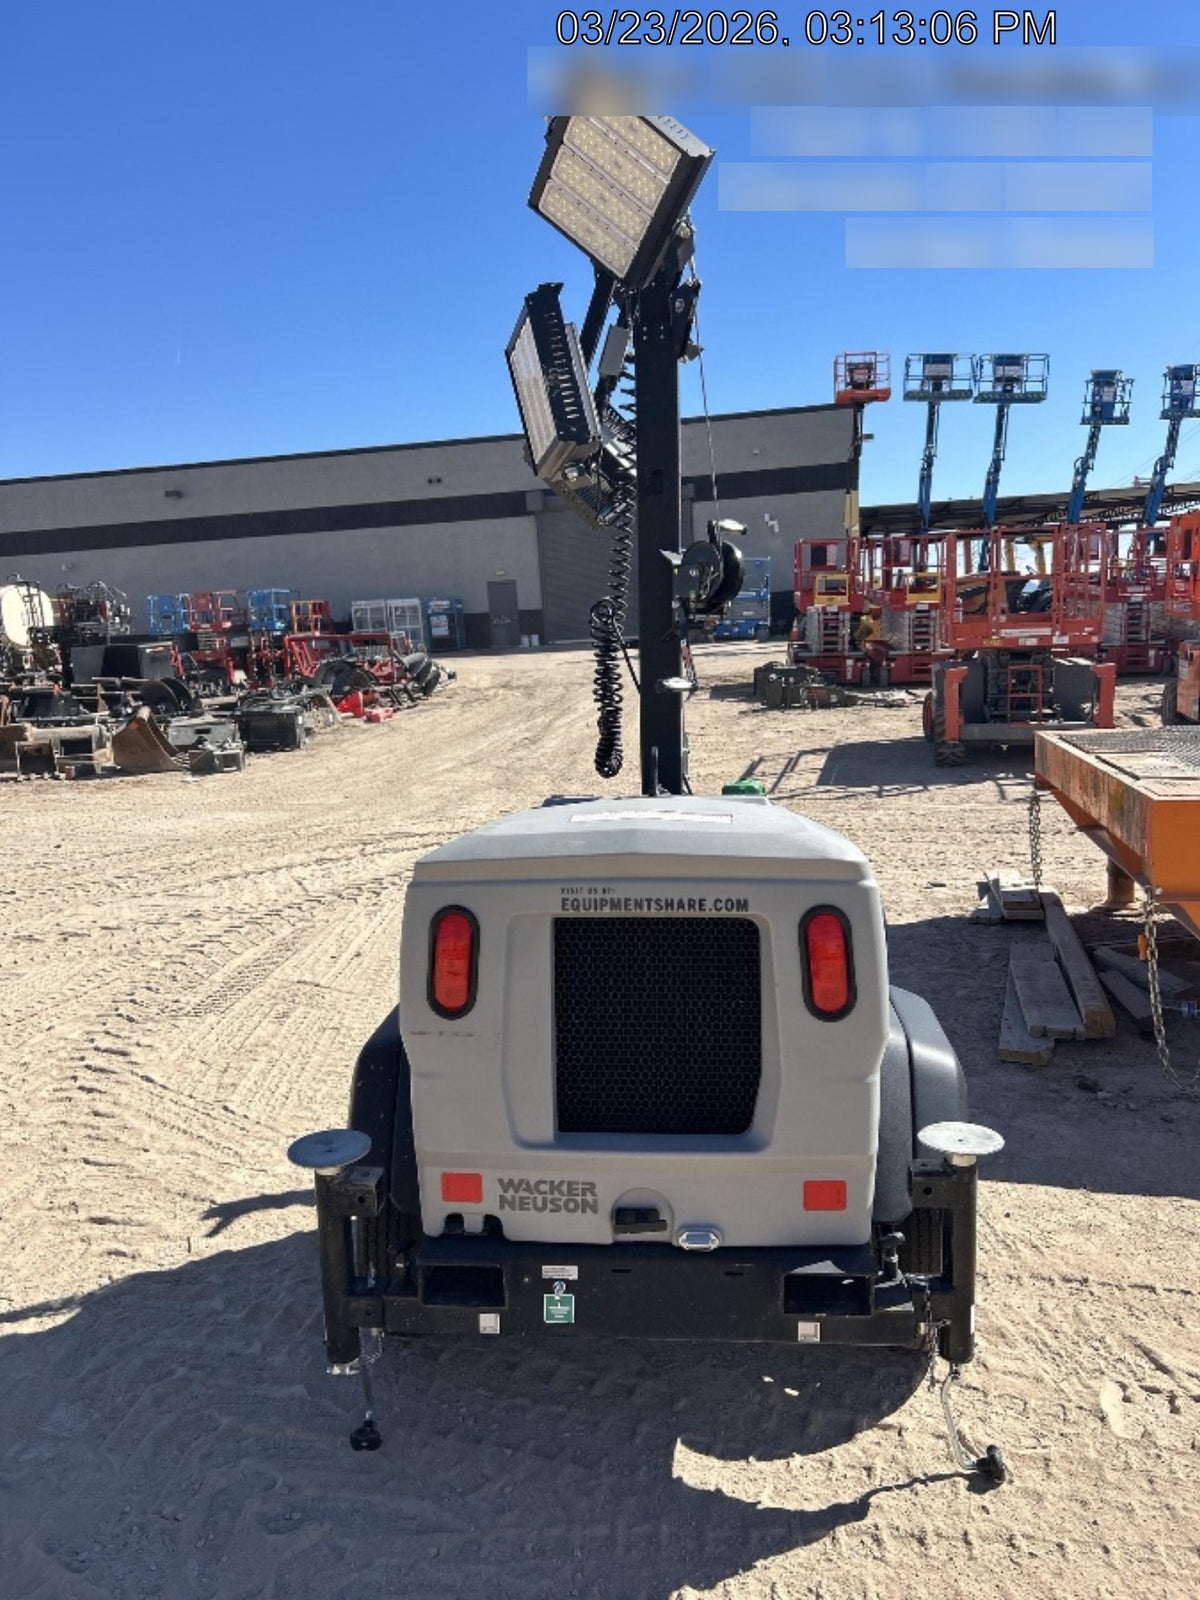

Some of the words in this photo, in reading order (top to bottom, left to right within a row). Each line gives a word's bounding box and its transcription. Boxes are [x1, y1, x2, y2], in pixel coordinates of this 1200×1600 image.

[561, 897, 749, 912] EQUIPMENTSHARE.COM
[497, 1178, 597, 1197] WACKER
[498, 1194, 599, 1214] NEUSON
